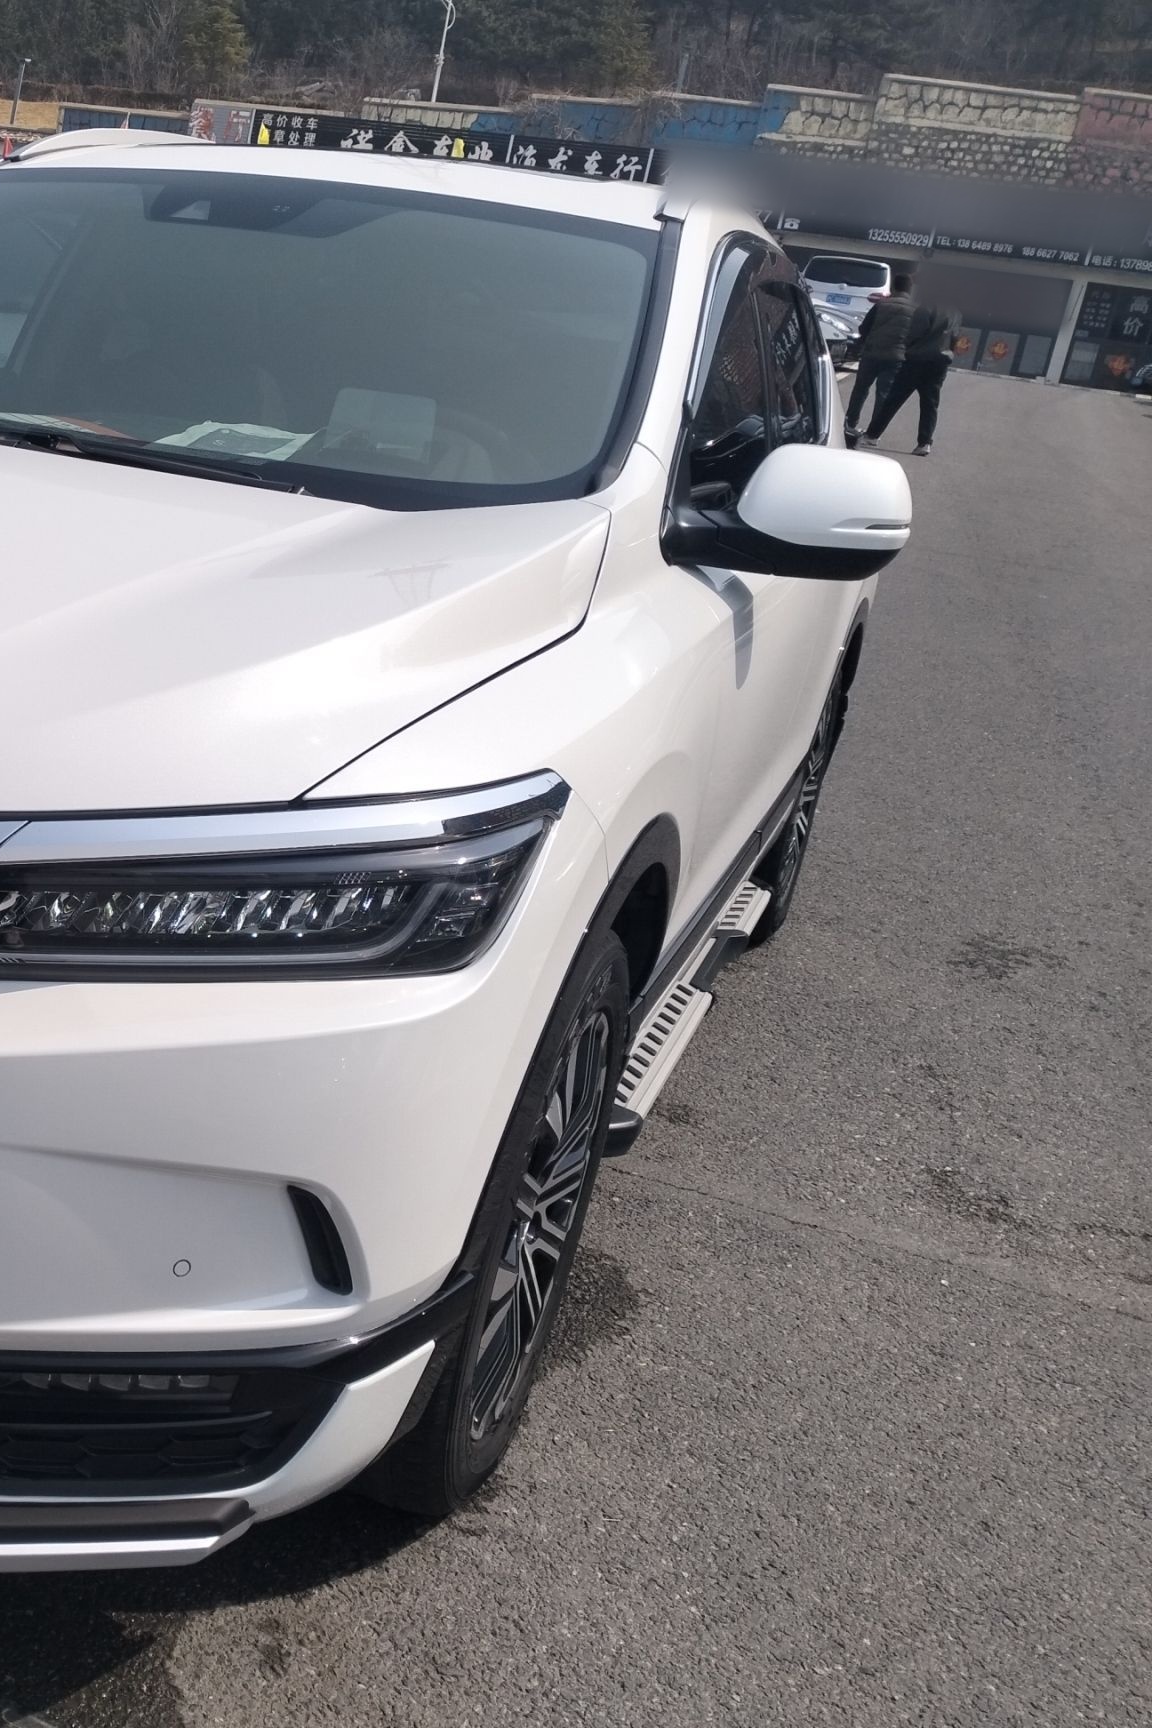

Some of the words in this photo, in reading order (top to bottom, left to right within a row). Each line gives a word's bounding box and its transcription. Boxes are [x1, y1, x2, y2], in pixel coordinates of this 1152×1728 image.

[261, 113, 319, 129] 高价收车
[261, 128, 317, 147] 章处理
[868, 228, 929, 247] 13255550929
